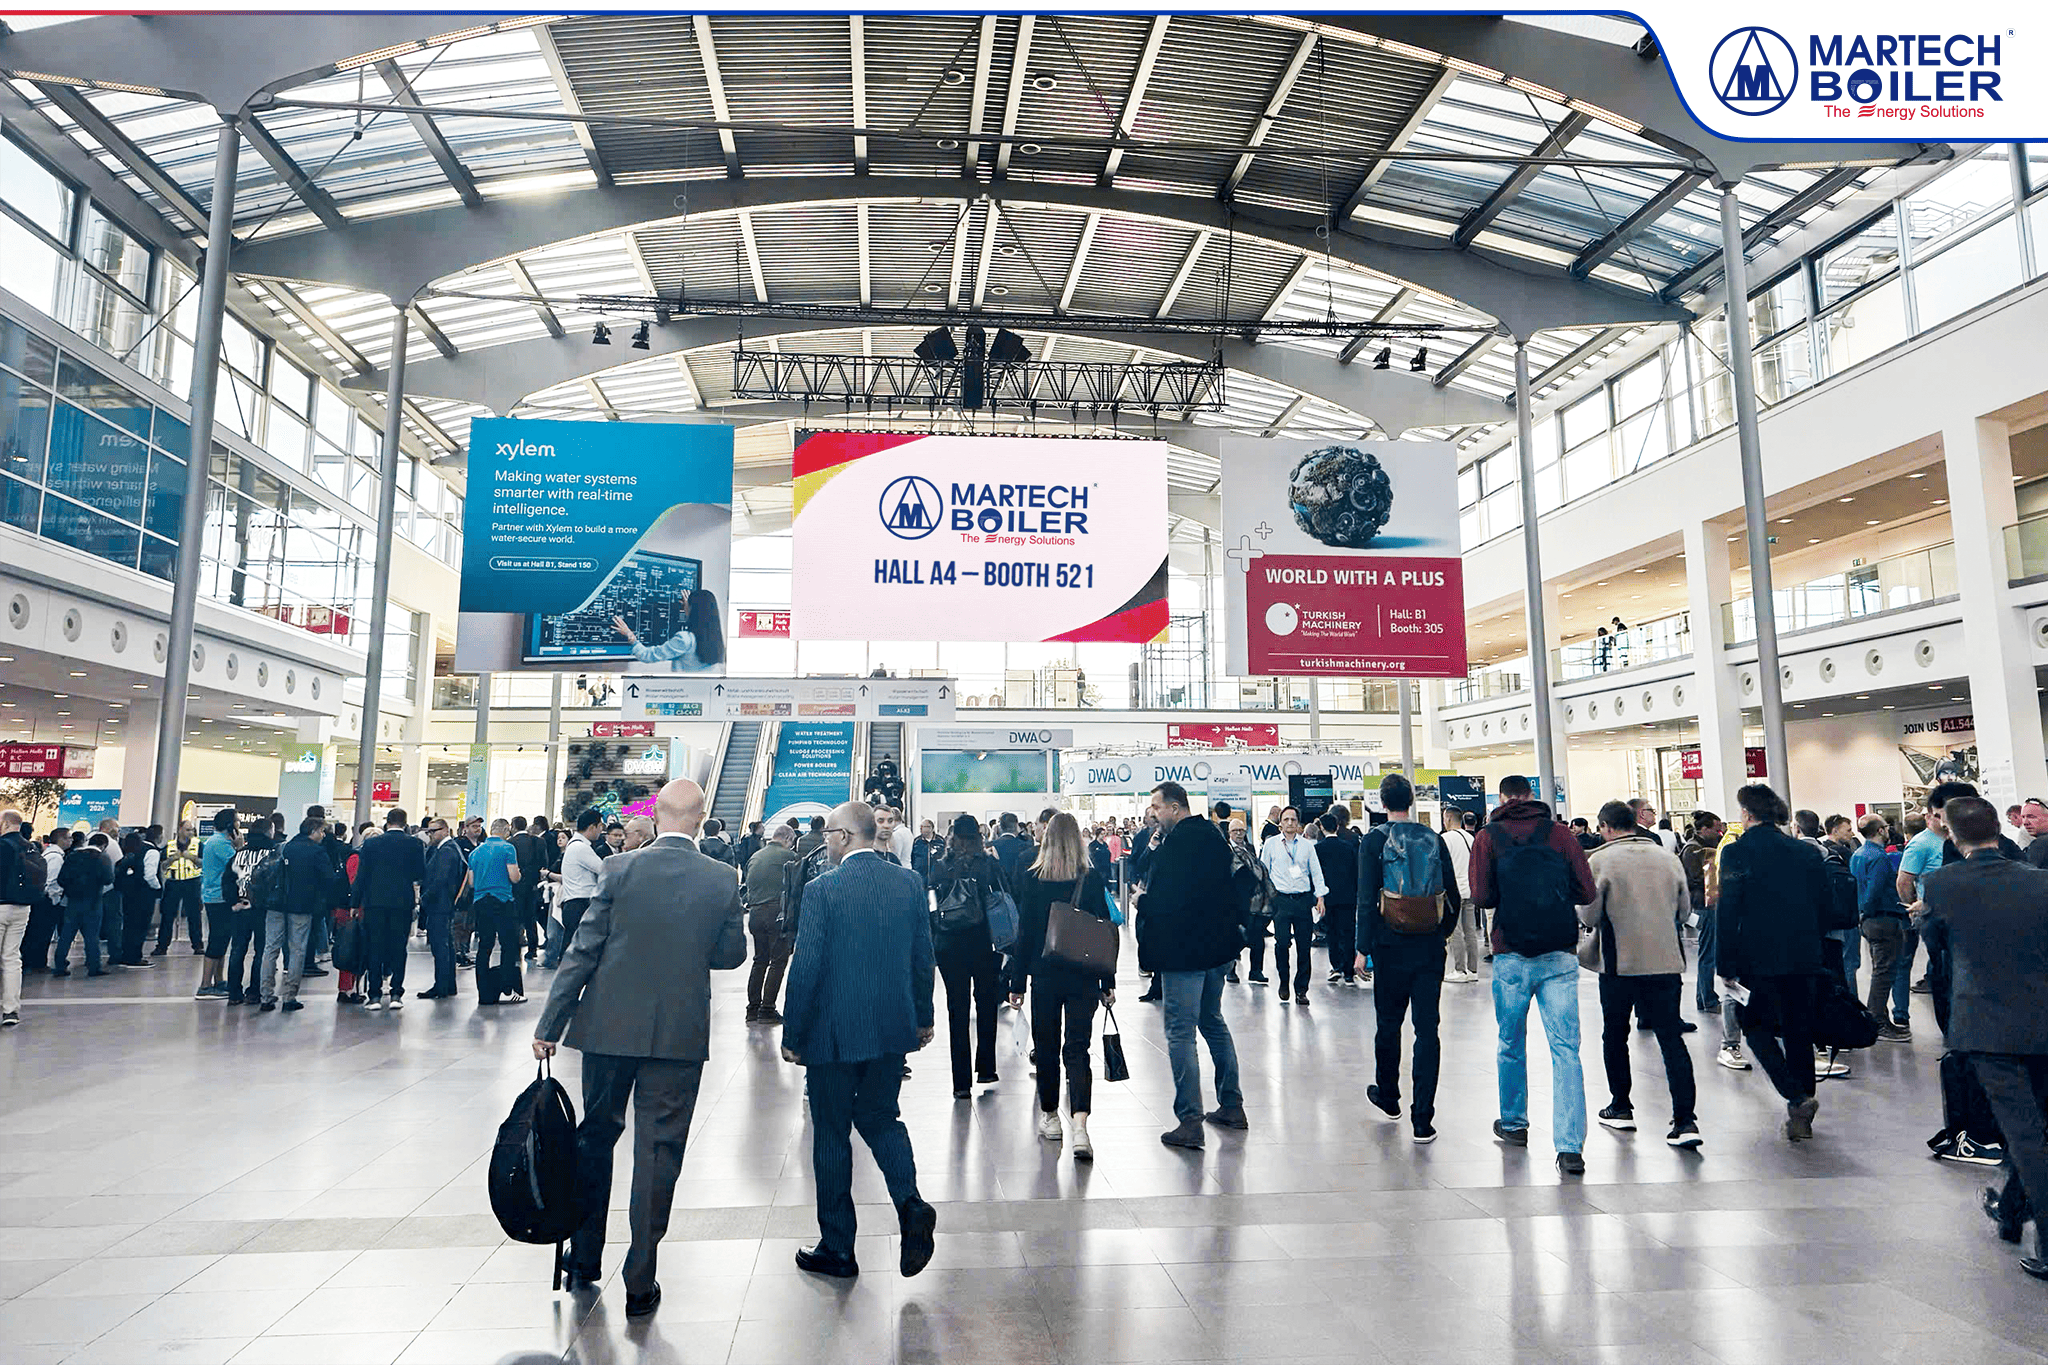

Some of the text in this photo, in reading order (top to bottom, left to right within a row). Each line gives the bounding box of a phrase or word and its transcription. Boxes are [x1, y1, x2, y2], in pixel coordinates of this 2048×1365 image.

[495, 438, 556, 461] xylem
[495, 470, 637, 487] Making water systems
[493, 488, 633, 501] smarter with real-time
[951, 482, 1088, 509] MARTECH
[492, 503, 569, 517] intelligence.
[951, 508, 1089, 534] BOILER
[491, 522, 524, 532] Partner
[526, 523, 544, 532] with
[546, 524, 573, 534] Xylem
[574, 525, 583, 533] to
[585, 525, 606, 533] build
[491, 535, 575, 543] water-secure world.
[961, 533, 1075, 546] The Energy Solutions
[874, 559, 924, 584] HALL
[930, 560, 957, 585] A4
[984, 562, 1049, 587] BOOTH
[1056, 563, 1093, 588] 521
[1265, 568, 1445, 587] WORLD WITH A PLUS
[1302, 611, 1345, 620] TURKISH
[1390, 609, 1426, 619] Hall: B1
[1302, 620, 1362, 629] MACHINERY
[1390, 624, 1443, 634] Booth: 305
[1300, 658, 1406, 671] turkishmachinery.org
[1904, 722, 1924, 735] JOIN
[1926, 721, 1939, 732] US
[1009, 731, 1039, 743] DWA
[1088, 768, 1116, 784] DWA
[1155, 766, 1192, 781] DWA
